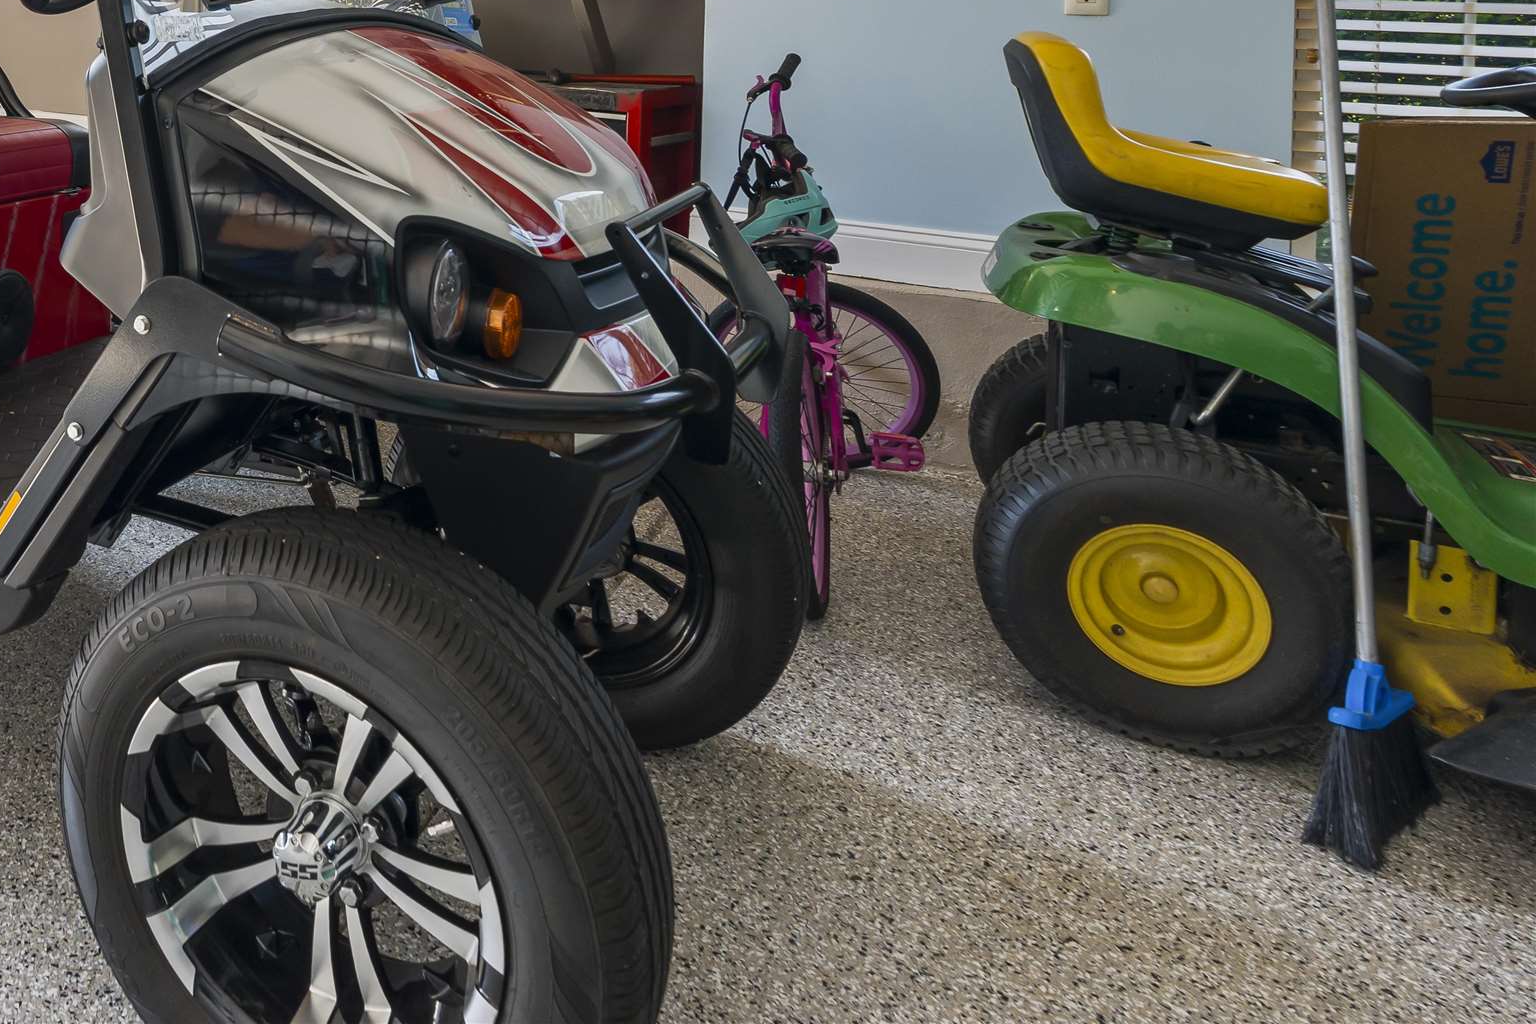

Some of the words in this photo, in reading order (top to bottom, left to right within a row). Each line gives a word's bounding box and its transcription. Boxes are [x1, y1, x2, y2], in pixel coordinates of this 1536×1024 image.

[1384, 193, 1456, 368] Welcome
[1447, 259, 1519, 380] home.
[118, 594, 195, 653] ECO-2
